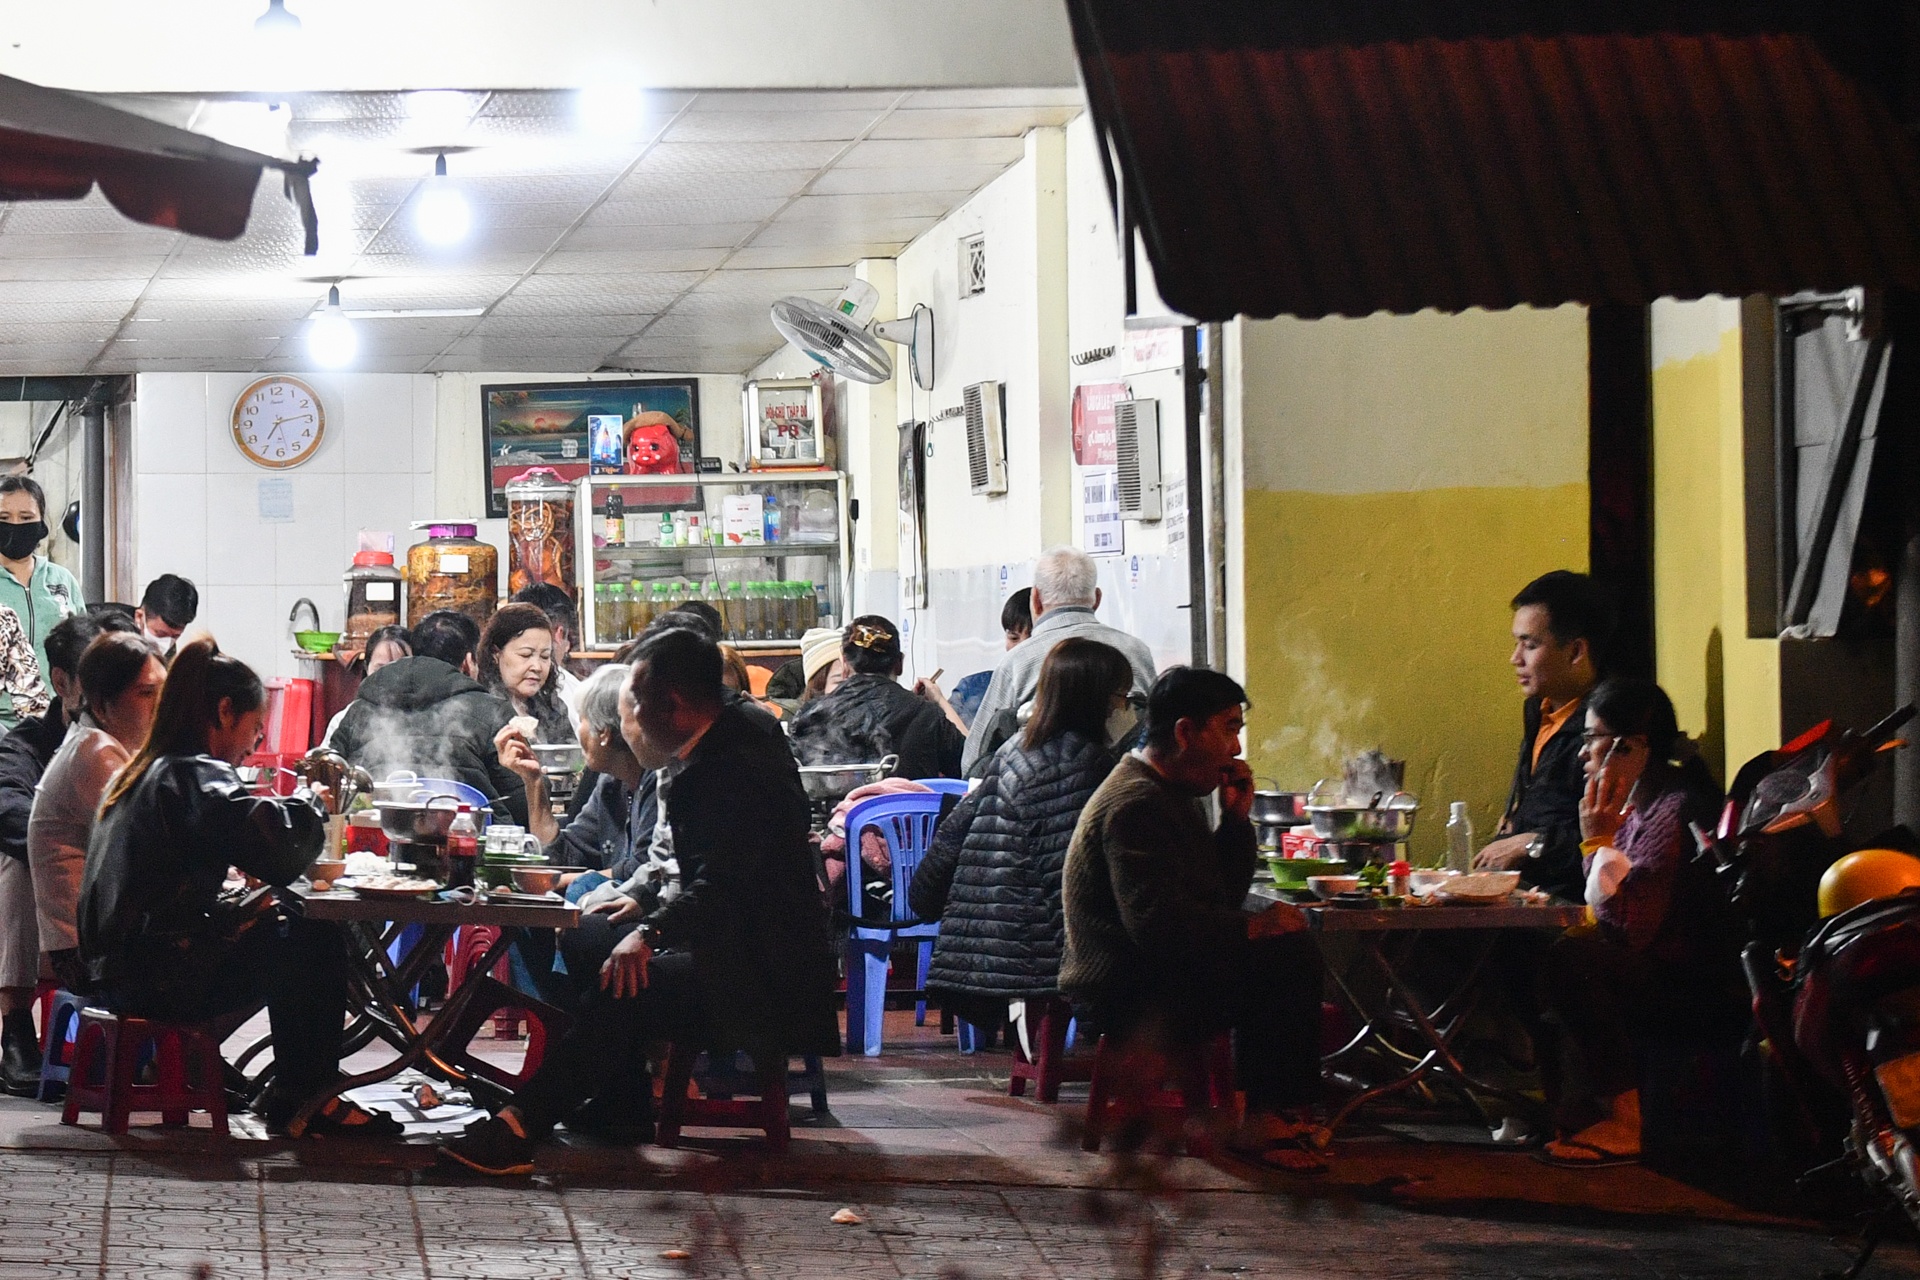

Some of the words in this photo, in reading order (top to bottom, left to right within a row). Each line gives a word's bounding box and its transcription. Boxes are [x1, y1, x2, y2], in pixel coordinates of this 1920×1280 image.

[270, 386, 283, 396] 12
[255, 393, 265, 402] 11
[300, 399, 309, 409] 2
[245, 405, 259, 415] 10
[304, 414, 314, 424] 3
[243, 420, 253, 430] 9
[301, 428, 311, 438] 4
[248, 435, 258, 445] 8
[261, 445, 270, 456] 7
[291, 441, 301, 451] 5
[276, 448, 286, 457] 6
